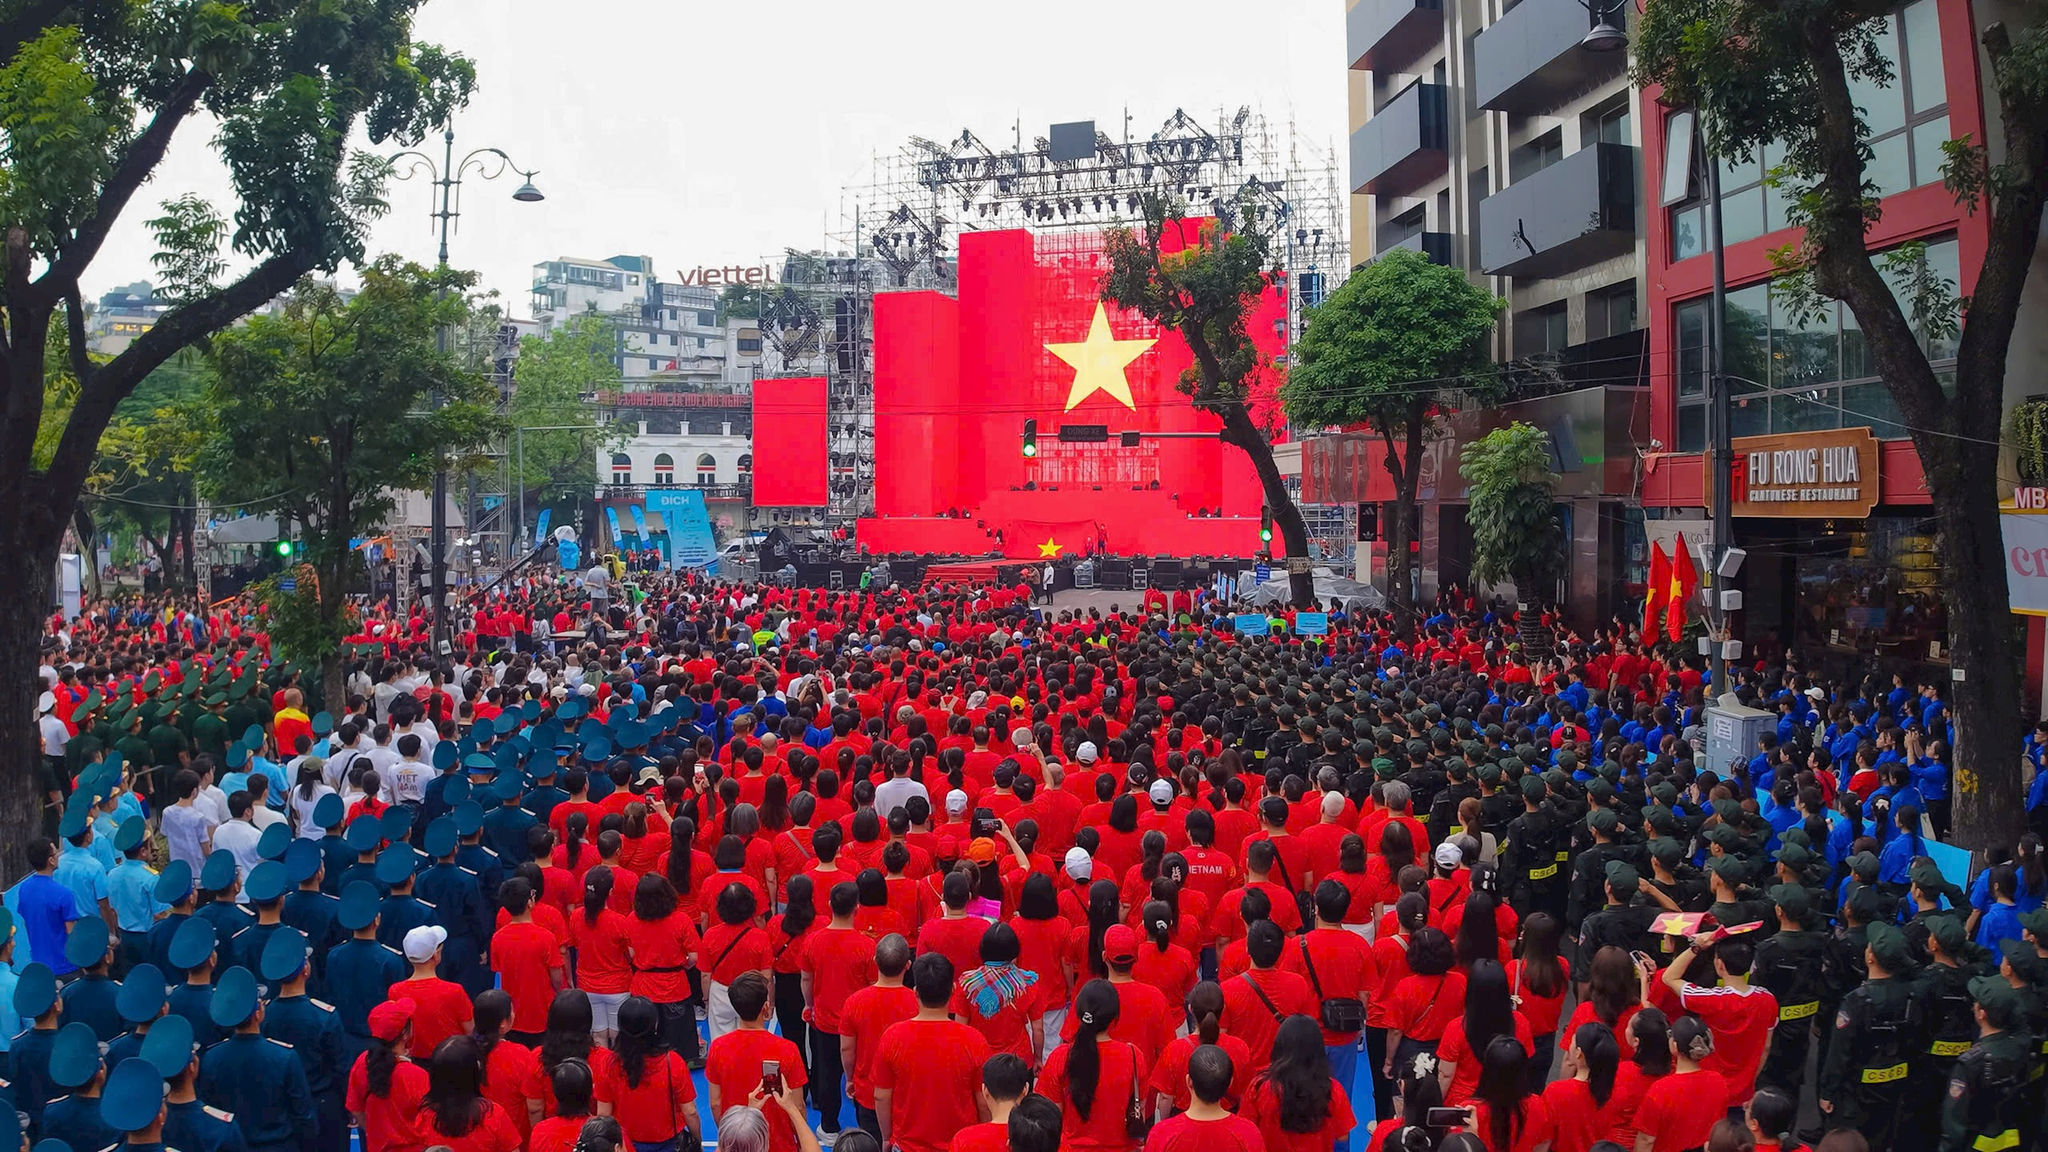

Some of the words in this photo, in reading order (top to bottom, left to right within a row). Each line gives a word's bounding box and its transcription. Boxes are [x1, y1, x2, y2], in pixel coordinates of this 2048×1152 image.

[677, 265, 775, 286] viettel
[1749, 452, 1770, 485] FU
[1774, 448, 1818, 485] RONG
[1823, 446, 1859, 483] HUA
[1801, 488, 1859, 501] RESTAURANT
[2014, 487, 2046, 509] MB
[1188, 865, 1222, 874] IETNAM
